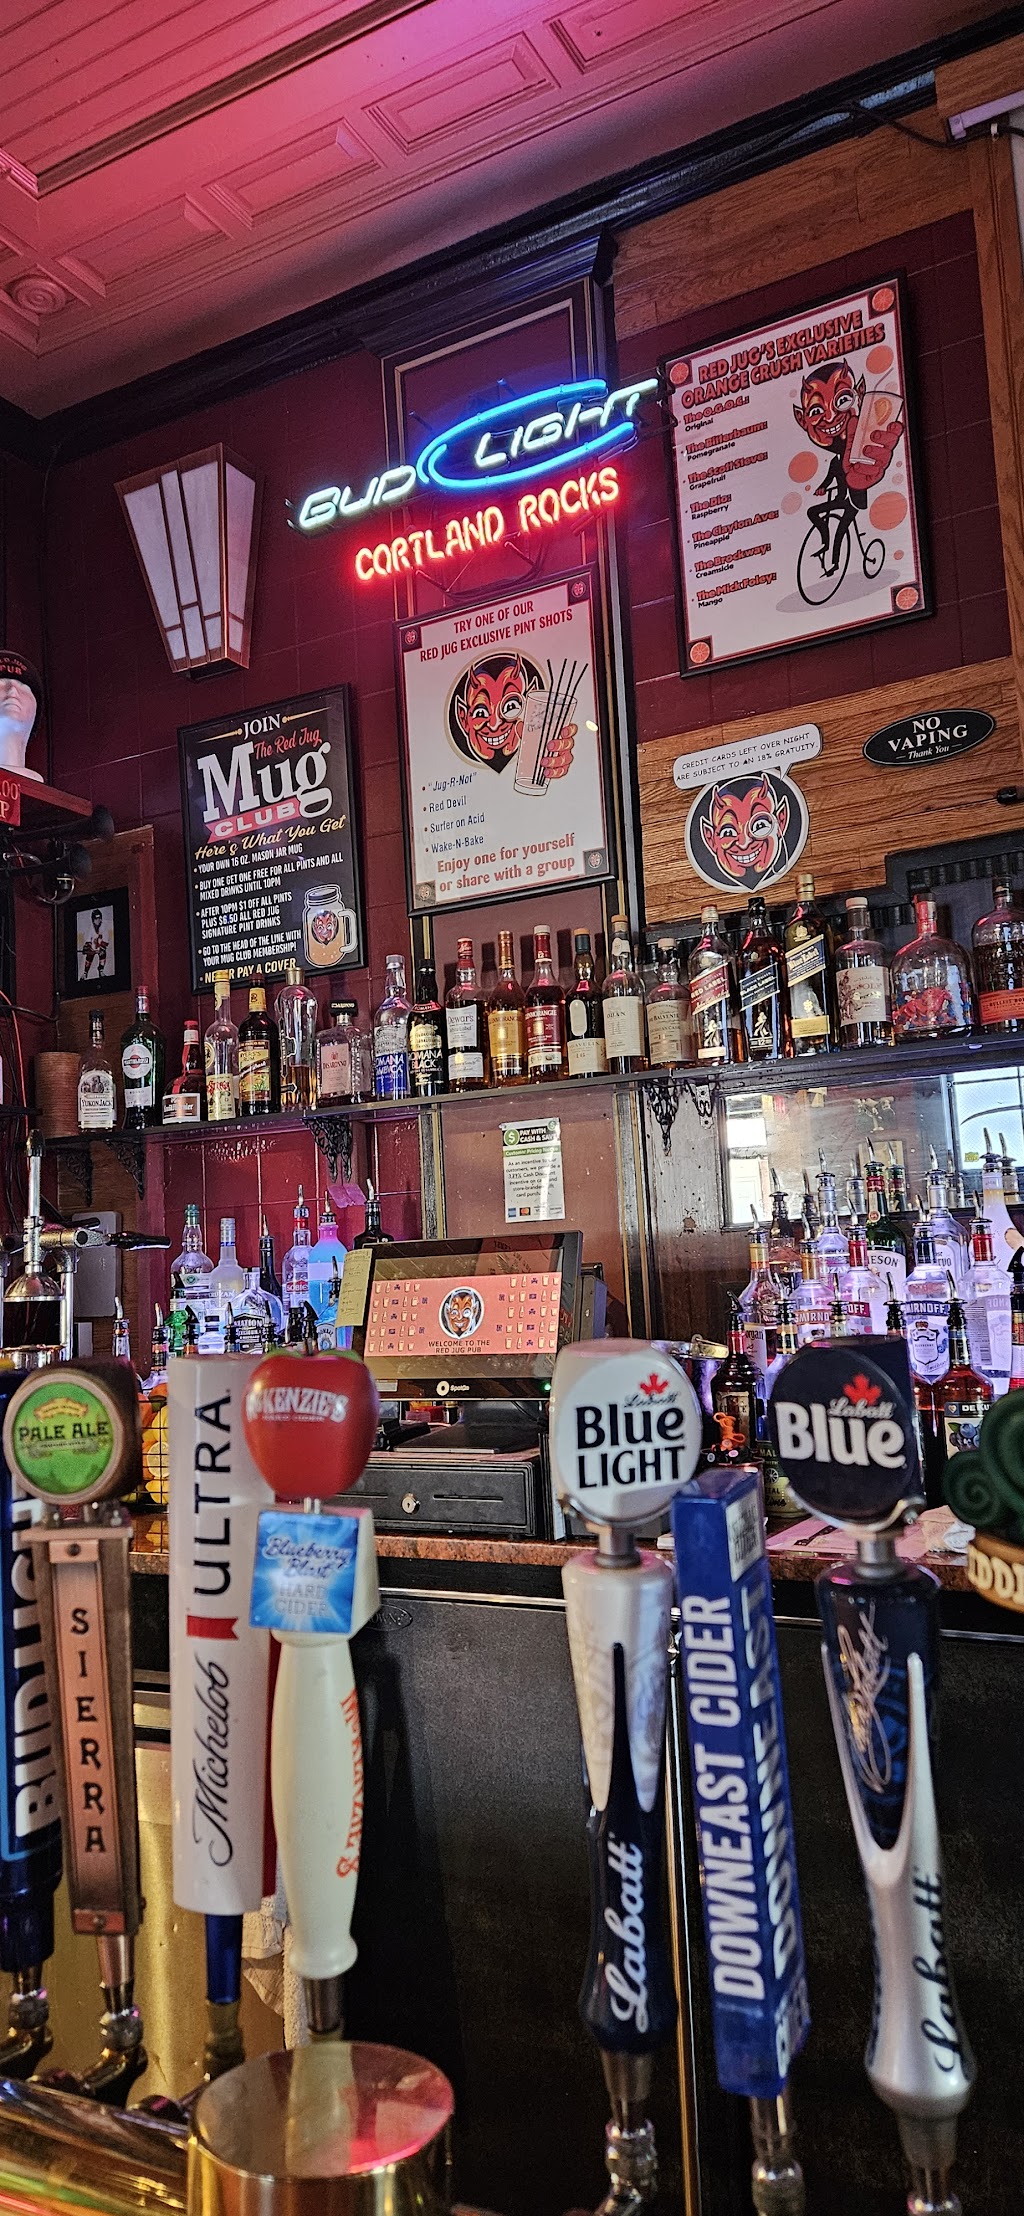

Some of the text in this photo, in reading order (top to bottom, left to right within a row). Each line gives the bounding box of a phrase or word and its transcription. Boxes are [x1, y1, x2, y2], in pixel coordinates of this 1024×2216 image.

[698, 309, 864, 385] RED JUG'S EXCLUSIVE
[681, 323, 886, 410] ORANGE CRUSH VARIETIES
[685, 418, 714, 432] Original
[299, 378, 658, 529] BUD LIGHT
[687, 441, 736, 461] Pomegranate
[690, 475, 726, 490] Grapefruit
[355, 466, 620, 580] CORTLAND ROCKS
[691, 504, 729, 520] Raspberry
[711, 510, 779, 537] Clayton Ave:
[693, 534, 730, 549] Pineapple
[695, 564, 734, 579] Creamsicle
[715, 580, 743, 597] Mick
[698, 597, 723, 608] Mango
[454, 600, 534, 634] TRY ONE OF OUR
[420, 609, 573, 662] RED JUG EXCLUSIVE PINT SHOTS
[243, 714, 281, 740] JOIN
[888, 724, 968, 752] VAPING
[912, 716, 941, 734] NO
[253, 727, 323, 760] The Red Jug
[682, 732, 810, 771] CREDIT CARDS LEFT OVER NIGHT
[908, 745, 950, 760] Thank You
[676, 772, 690, 782] ARE
[693, 765, 726, 779] SUBJECT
[729, 762, 740, 771] TO
[742, 758, 754, 768] AN
[757, 754, 772, 764] 18%
[197, 741, 333, 823] Mug
[429, 795, 466, 813] Red Devil
[214, 803, 297, 837] CLUB
[430, 812, 485, 833] Surfer on Acid
[194, 814, 347, 860] Here's What You Get
[431, 835, 484, 854] Wake-N-Bake
[198, 843, 303, 874] YOUR OWN MASON JAR MUG
[437, 832, 575, 874] Enjoy one for yourself
[199, 852, 343, 892] BUY ONE GET ONE FREE FOR ALL PINTS AND ALL
[440, 857, 575, 892] or share with a group
[200, 876, 282, 902] MIXED DRINKS UNTIL 10PM
[201, 890, 293, 918] AFTER 10PM OFF ALL PINTS
[201, 905, 280, 929] PLUS ALL RED JUG
[202, 915, 282, 940] SIGNATURE PINT DRINKS
[203, 942, 297, 967] YOUR MUG CLUB MEMBERSHIP!
[220, 929, 302, 955] THE HEAD LINE WITH
[236, 958, 297, 980] PAY COVER
[520, 1134, 536, 1143] CASH
[531, 1127, 547, 1135] WITH
[870, 1254, 899, 1268] ESON
[795, 1311, 831, 1323] SMIRNO
[428, 1340, 462, 1348] WELCOME
[624, 1393, 679, 1409] Labatt
[827, 1396, 896, 1420] Labatt
[19, 1421, 109, 1442] PALE ALE
[576, 1403, 685, 1450] Blue
[775, 1401, 907, 1469] Blue
[578, 1445, 686, 1489] LIGHT
[194, 1394, 232, 1598] ULTRA
[265, 1537, 350, 1570] Blueberry
[283, 1557, 332, 1579] Blast
[278, 1583, 327, 1598] HARD
[273, 1599, 329, 1617] CIDER
[68, 1606, 108, 1855] SIERRA
[192, 1652, 233, 1868] Michelob
[681, 1594, 765, 2001] DOWNEAST CIDER
[604, 1840, 649, 2034] Labatt
